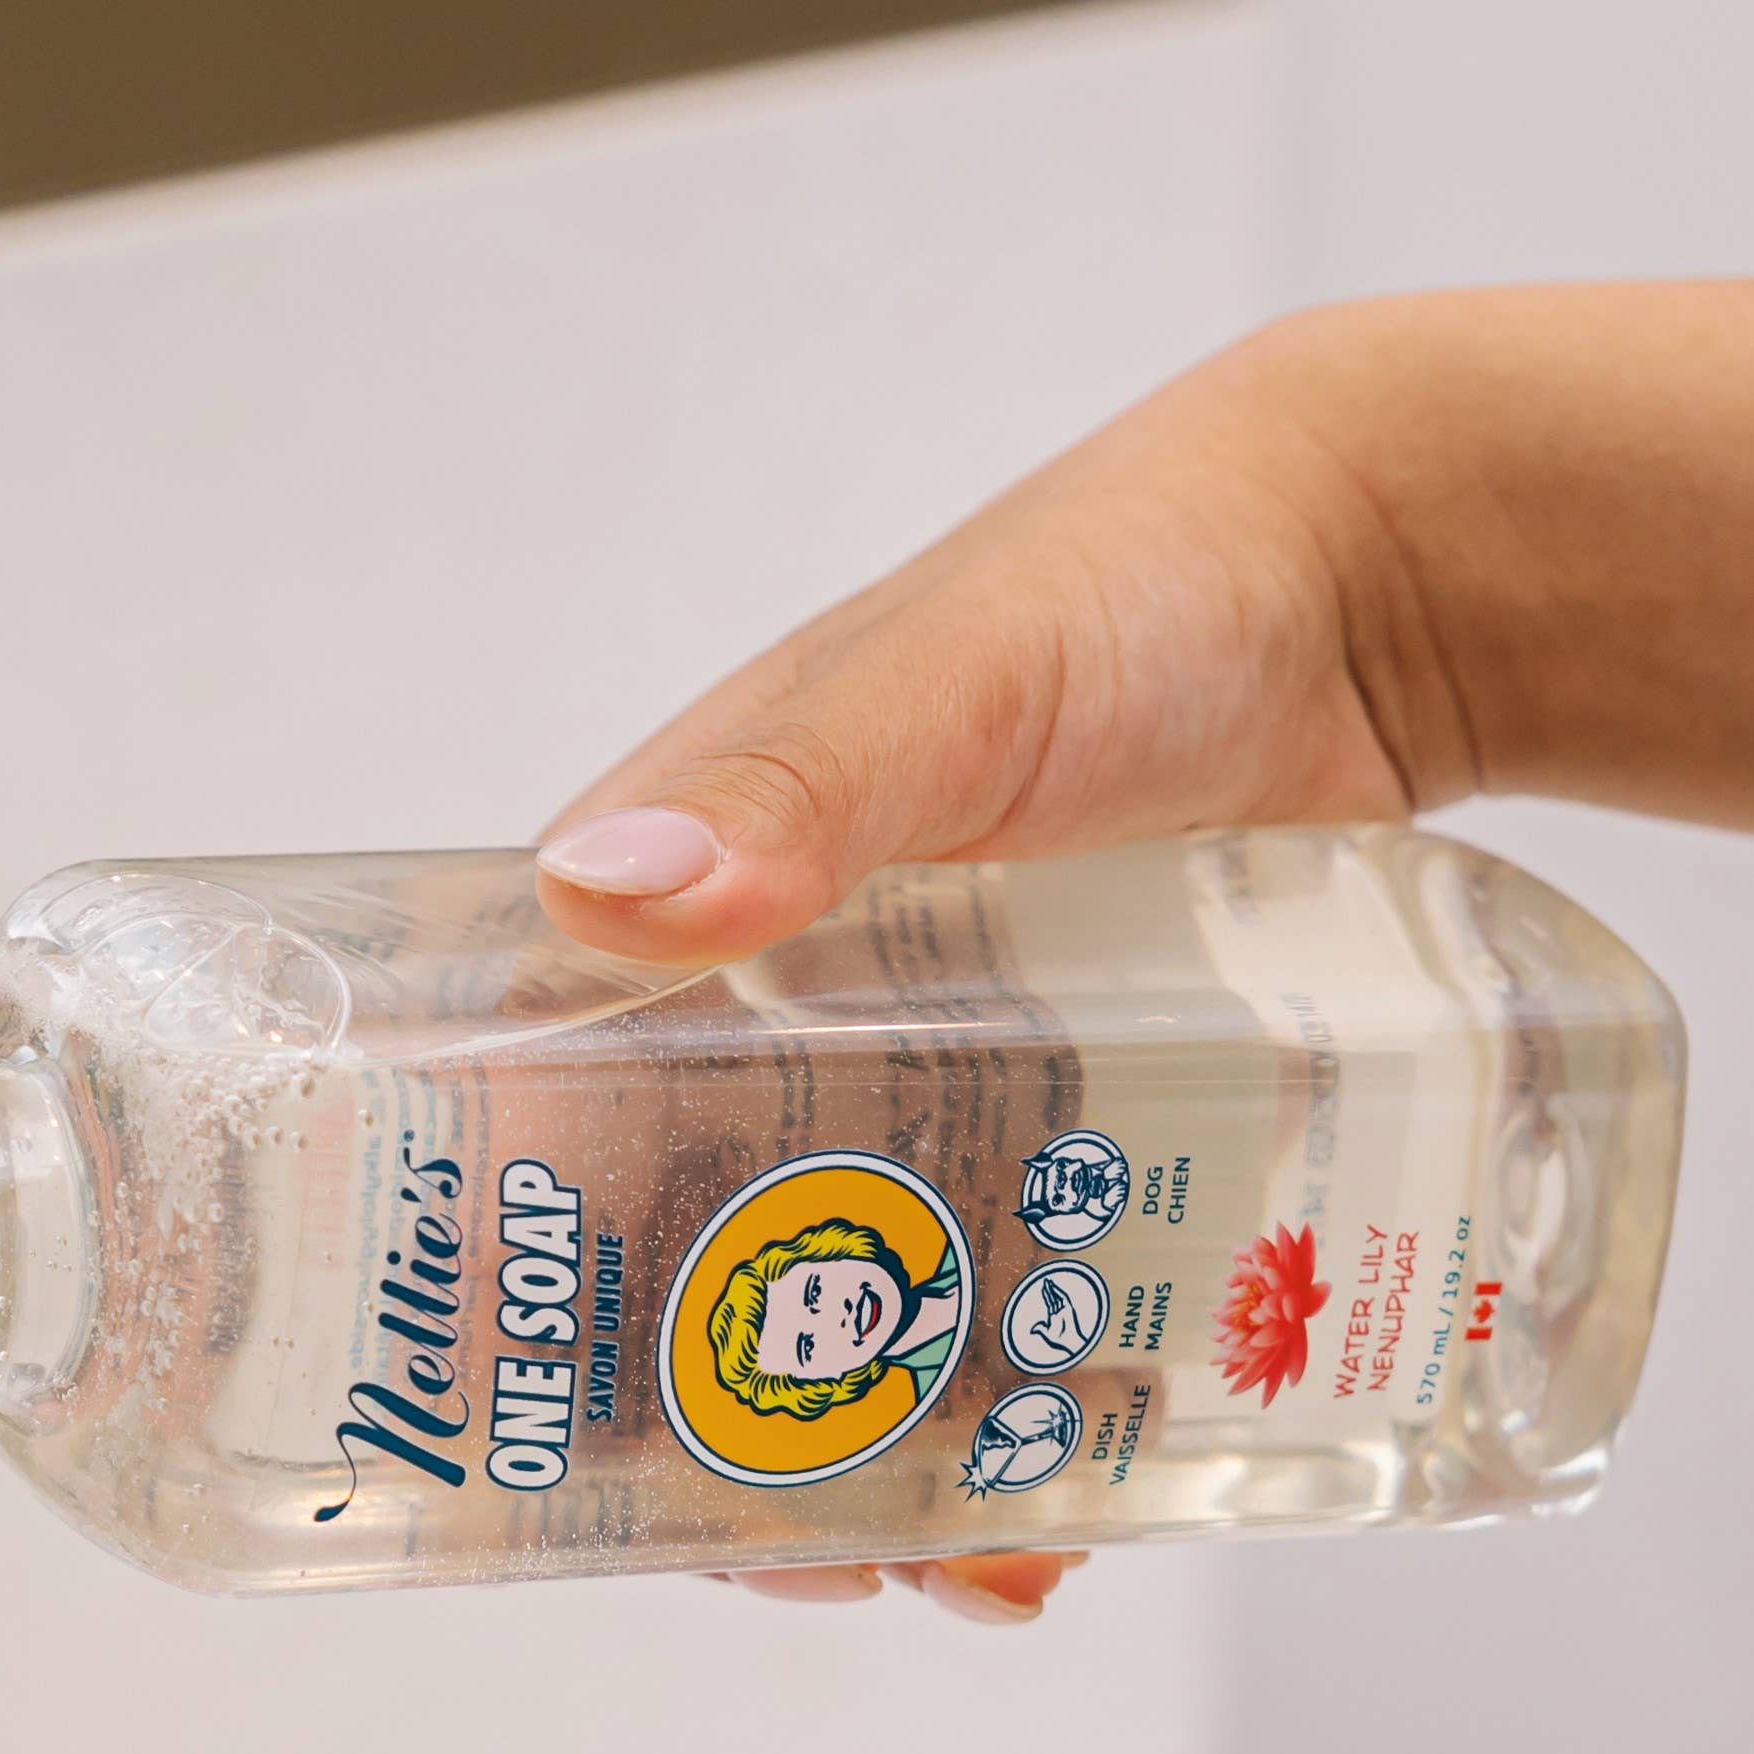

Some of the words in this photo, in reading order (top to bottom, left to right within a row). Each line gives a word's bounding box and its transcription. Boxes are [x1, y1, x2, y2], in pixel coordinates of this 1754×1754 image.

[1142, 1166, 1164, 1216] DOG
[1168, 1156, 1191, 1224] CHIEN
[497, 1157, 583, 1347] SOAP
[1119, 1285, 1145, 1348] HAND
[1145, 1281, 1172, 1351] MAINS
[1333, 1297, 1375, 1399] WATER
[1359, 1224, 1388, 1284] LILY
[1367, 1231, 1420, 1391] NENUPHAR
[1417, 1363, 1440, 1404] 570
[1433, 1324, 1451, 1356] mL
[1443, 1250, 1467, 1299] 19.2
[1457, 1216, 1471, 1240] oz
[486, 1355, 577, 1492] ONE
[587, 1341, 619, 1422] SAVON
[1092, 1412, 1118, 1460] DISH
[1110, 1384, 1151, 1485] VAISSELLE
